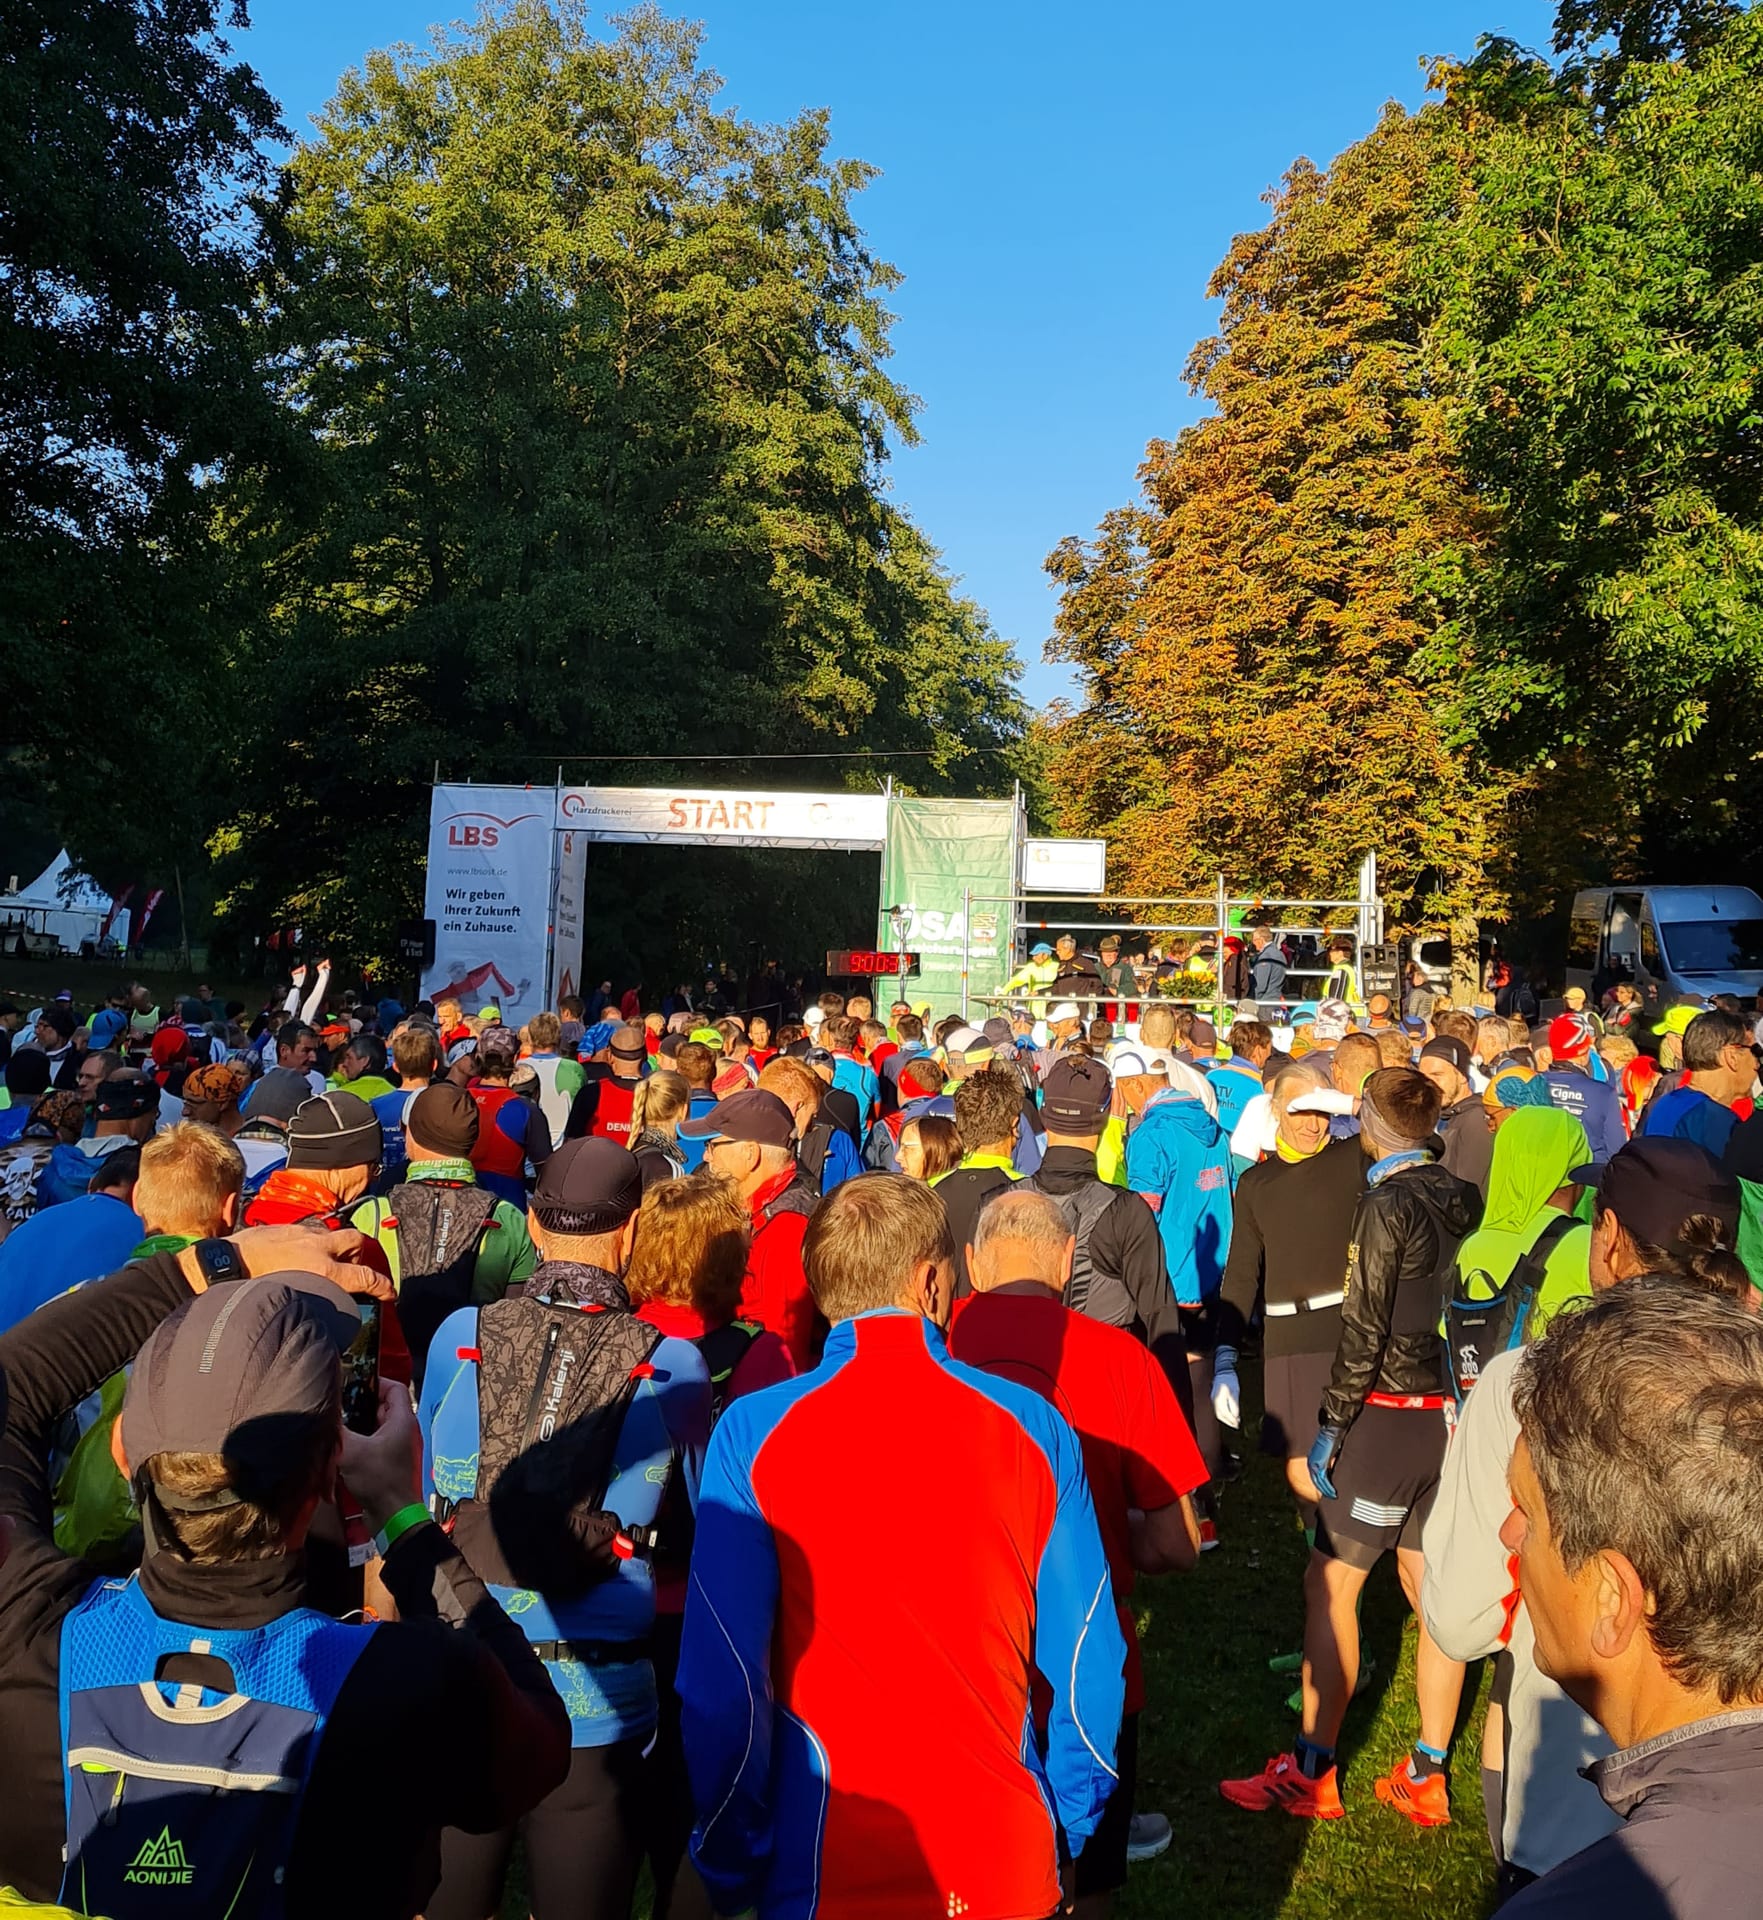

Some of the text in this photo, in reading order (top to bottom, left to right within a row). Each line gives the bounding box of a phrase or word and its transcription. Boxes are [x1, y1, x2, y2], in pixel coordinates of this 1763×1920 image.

[572, 805, 632, 816] Harzdruckerei
[667, 798, 775, 829] START
[448, 825, 499, 847] LBS
[446, 888, 505, 903] Wir geben
[444, 904, 521, 917] Ihrer Zukunft
[443, 920, 517, 933] ein Zuhause.
[544, 1349, 576, 1412] Kalenji
[123, 1869, 194, 1885] AONIJIE
